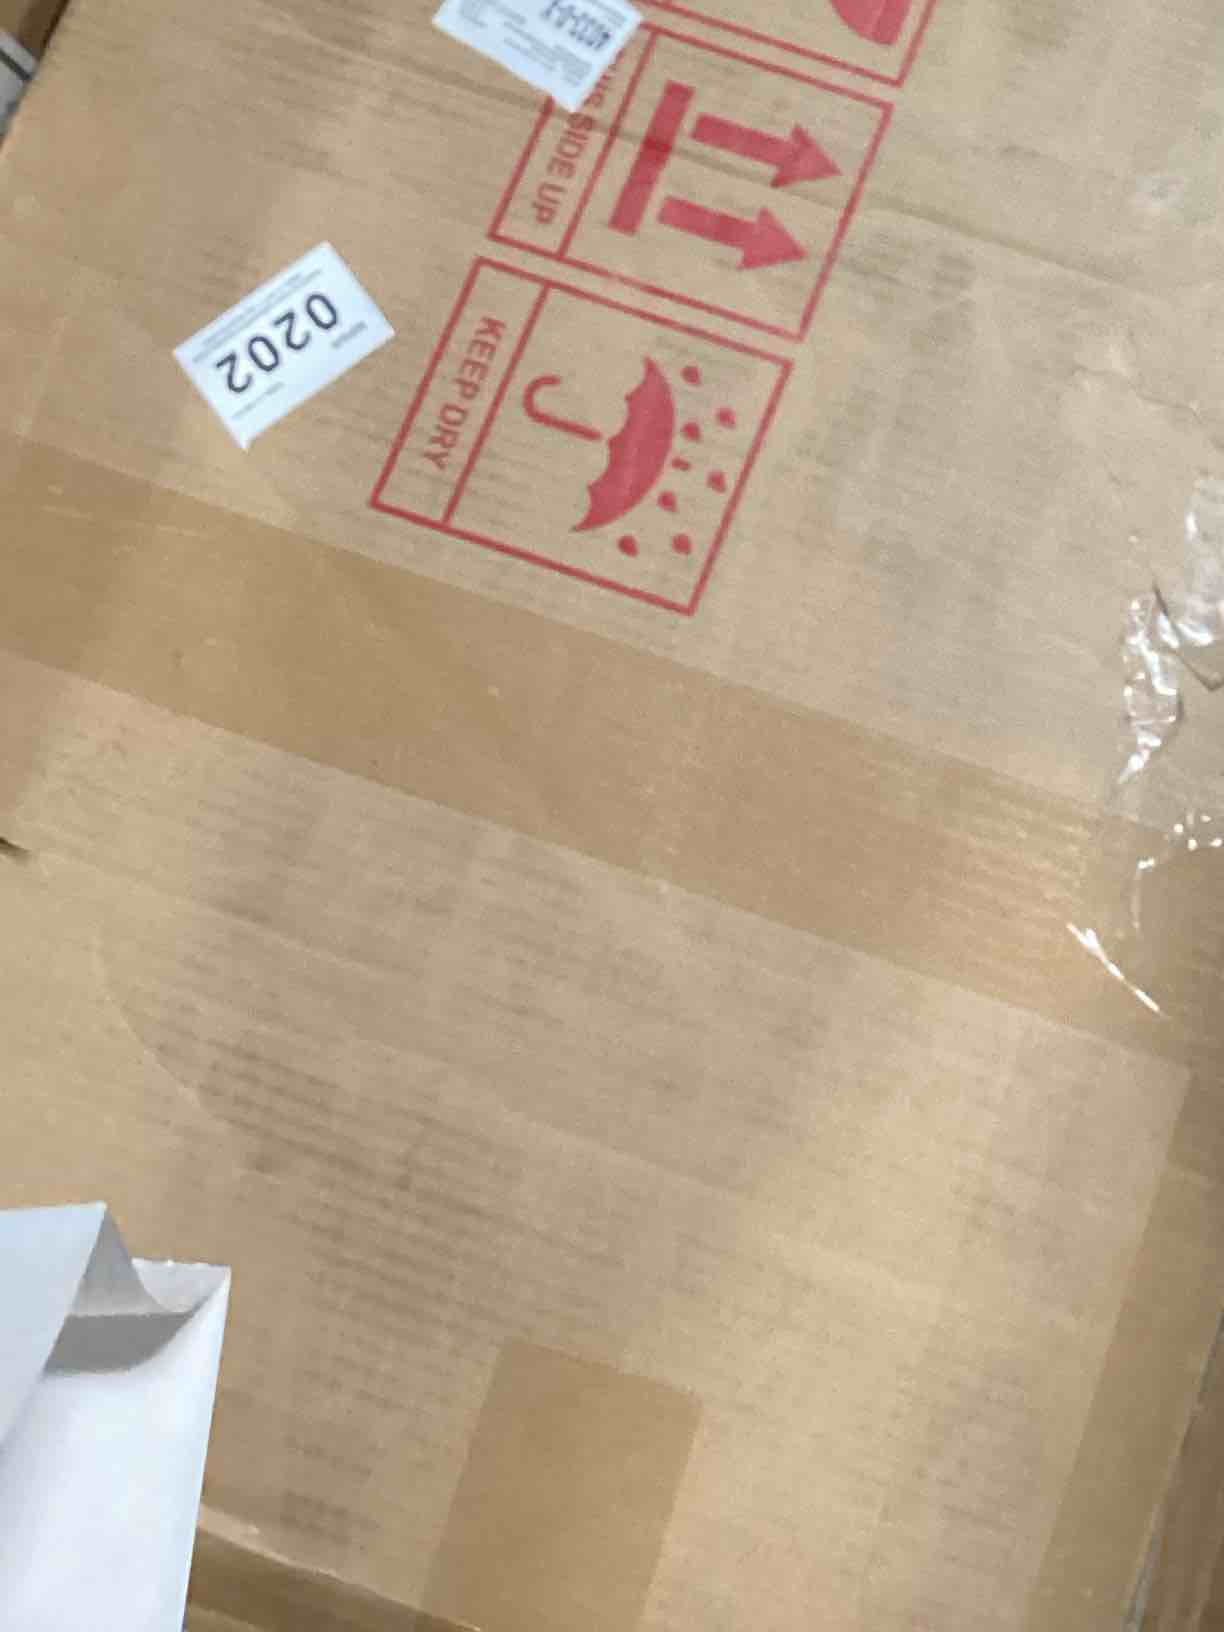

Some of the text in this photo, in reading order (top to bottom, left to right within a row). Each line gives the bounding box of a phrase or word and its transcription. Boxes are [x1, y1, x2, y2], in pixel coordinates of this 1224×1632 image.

[532, 112, 596, 225] SIDE UP
[214, 292, 339, 394] 0202
[422, 316, 508, 470] KEEP DRY
